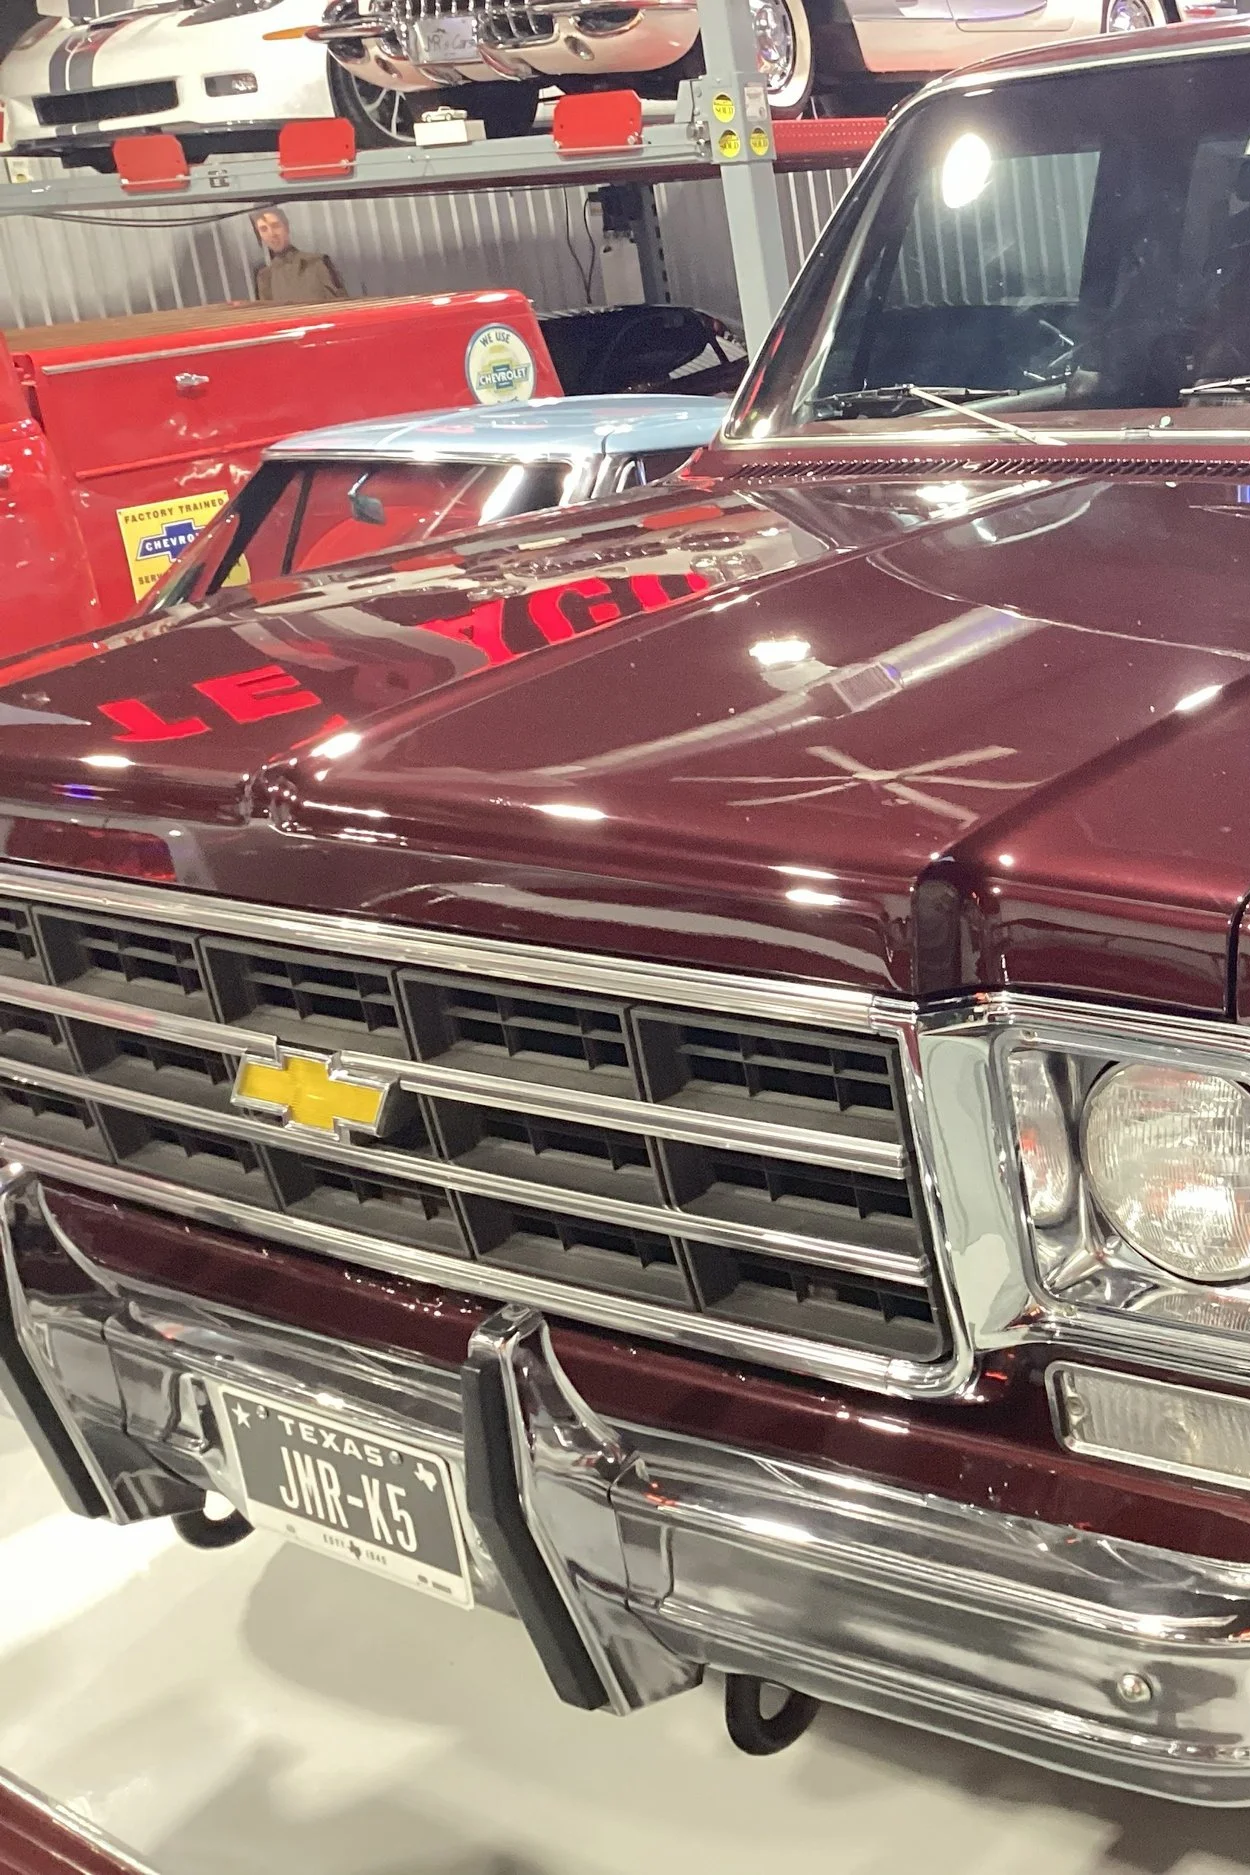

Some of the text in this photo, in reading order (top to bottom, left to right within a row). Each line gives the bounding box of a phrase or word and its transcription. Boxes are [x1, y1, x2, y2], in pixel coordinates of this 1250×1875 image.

[480, 331, 511, 347] WE USE
[480, 367, 527, 385] CHEVROLET
[124, 497, 225, 524] FACTORY TRAINED
[145, 534, 195, 551] CHEVRO
[277, 1415, 384, 1467] TEXAS
[279, 1446, 417, 1553] JMR-K5
